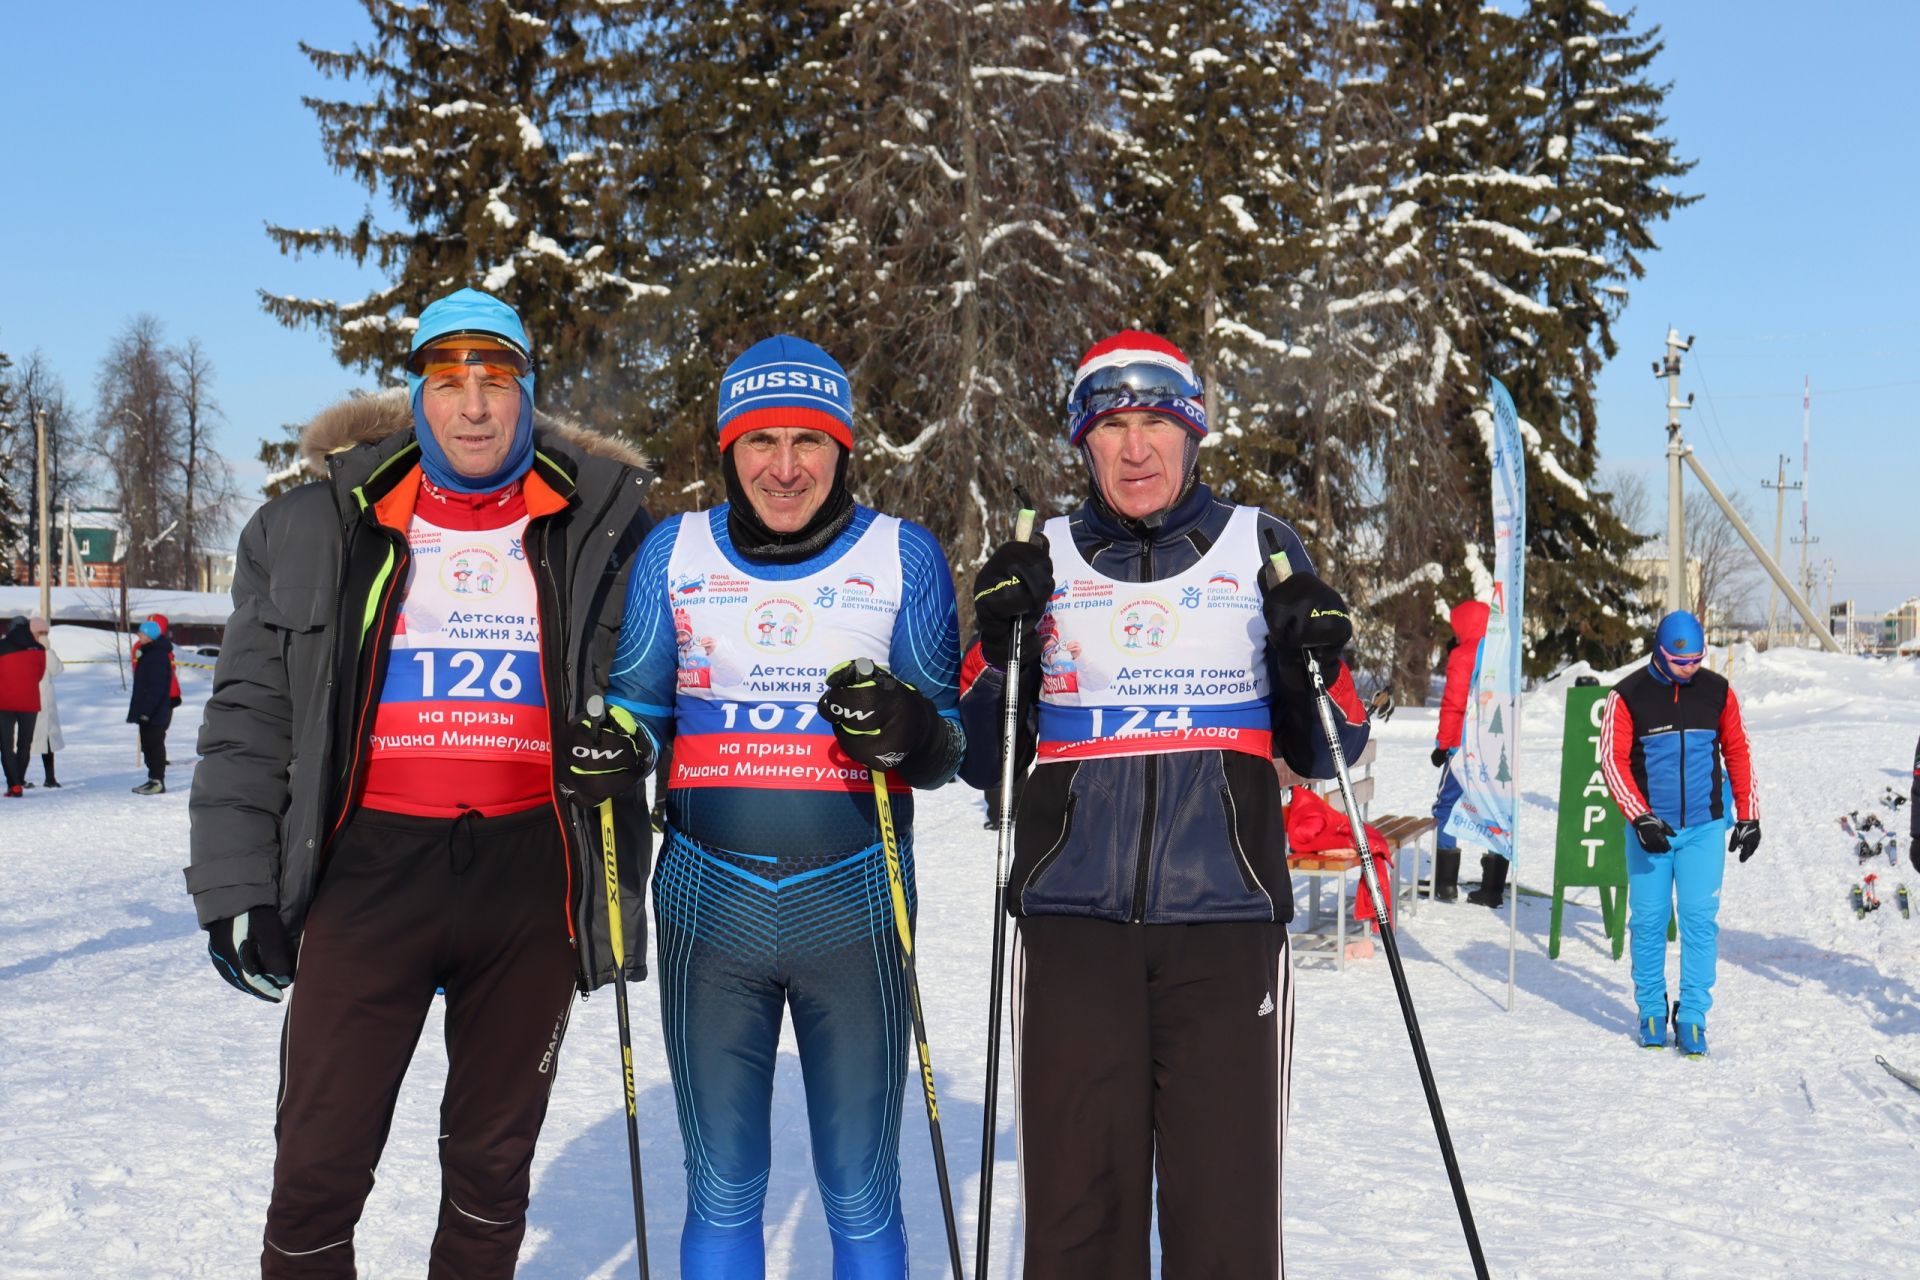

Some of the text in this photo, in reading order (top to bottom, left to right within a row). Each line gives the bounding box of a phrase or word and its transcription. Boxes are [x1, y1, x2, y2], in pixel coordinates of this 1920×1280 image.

[730, 371, 839, 400] RUSSIA
[411, 546, 441, 557] рана
[673, 594, 748, 607] диная страна
[1073, 599, 1113, 609] страна
[448, 610, 525, 625] Детская
[413, 651, 522, 700] 126
[750, 664, 826, 677] Детская
[1117, 667, 1246, 680] Детская гонка
[418, 711, 514, 726] на призы
[1089, 706, 1193, 737] 124
[719, 743, 811, 758] на призы
[677, 762, 869, 781] Рушана Миннегулова
[538, 1021, 560, 1074] CRAFT
